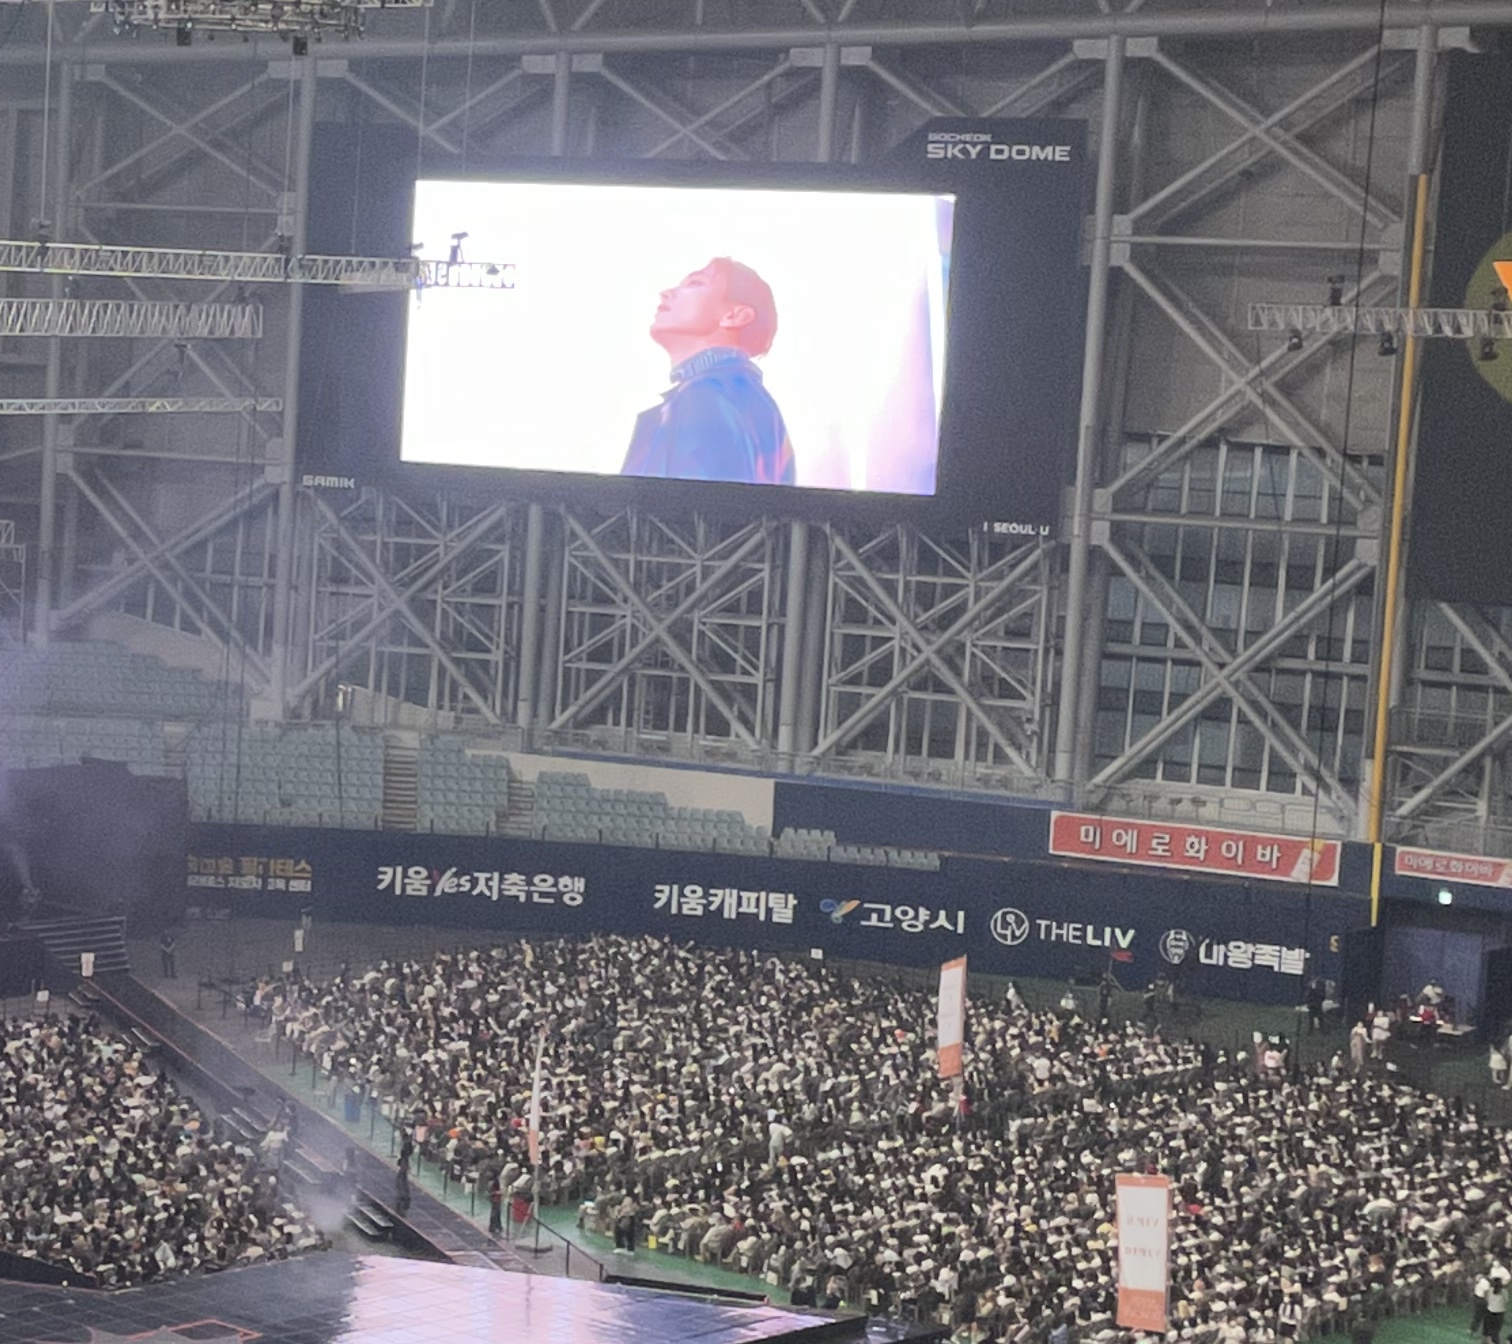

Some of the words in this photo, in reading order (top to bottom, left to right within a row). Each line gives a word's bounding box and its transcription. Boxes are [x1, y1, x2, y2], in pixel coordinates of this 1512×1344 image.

[926, 143, 984, 160] SKY
[989, 144, 1071, 162] DOME
[302, 474, 355, 489] SAMIK
[993, 521, 1036, 535] SEOUL
[1039, 525, 1049, 536] U
[1078, 823, 1282, 870] 미에로화이바
[653, 883, 798, 924] 키움캐피탈
[860, 902, 965, 934] 고양시
[1035, 919, 1082, 944] THE
[1086, 924, 1136, 949] LIV
